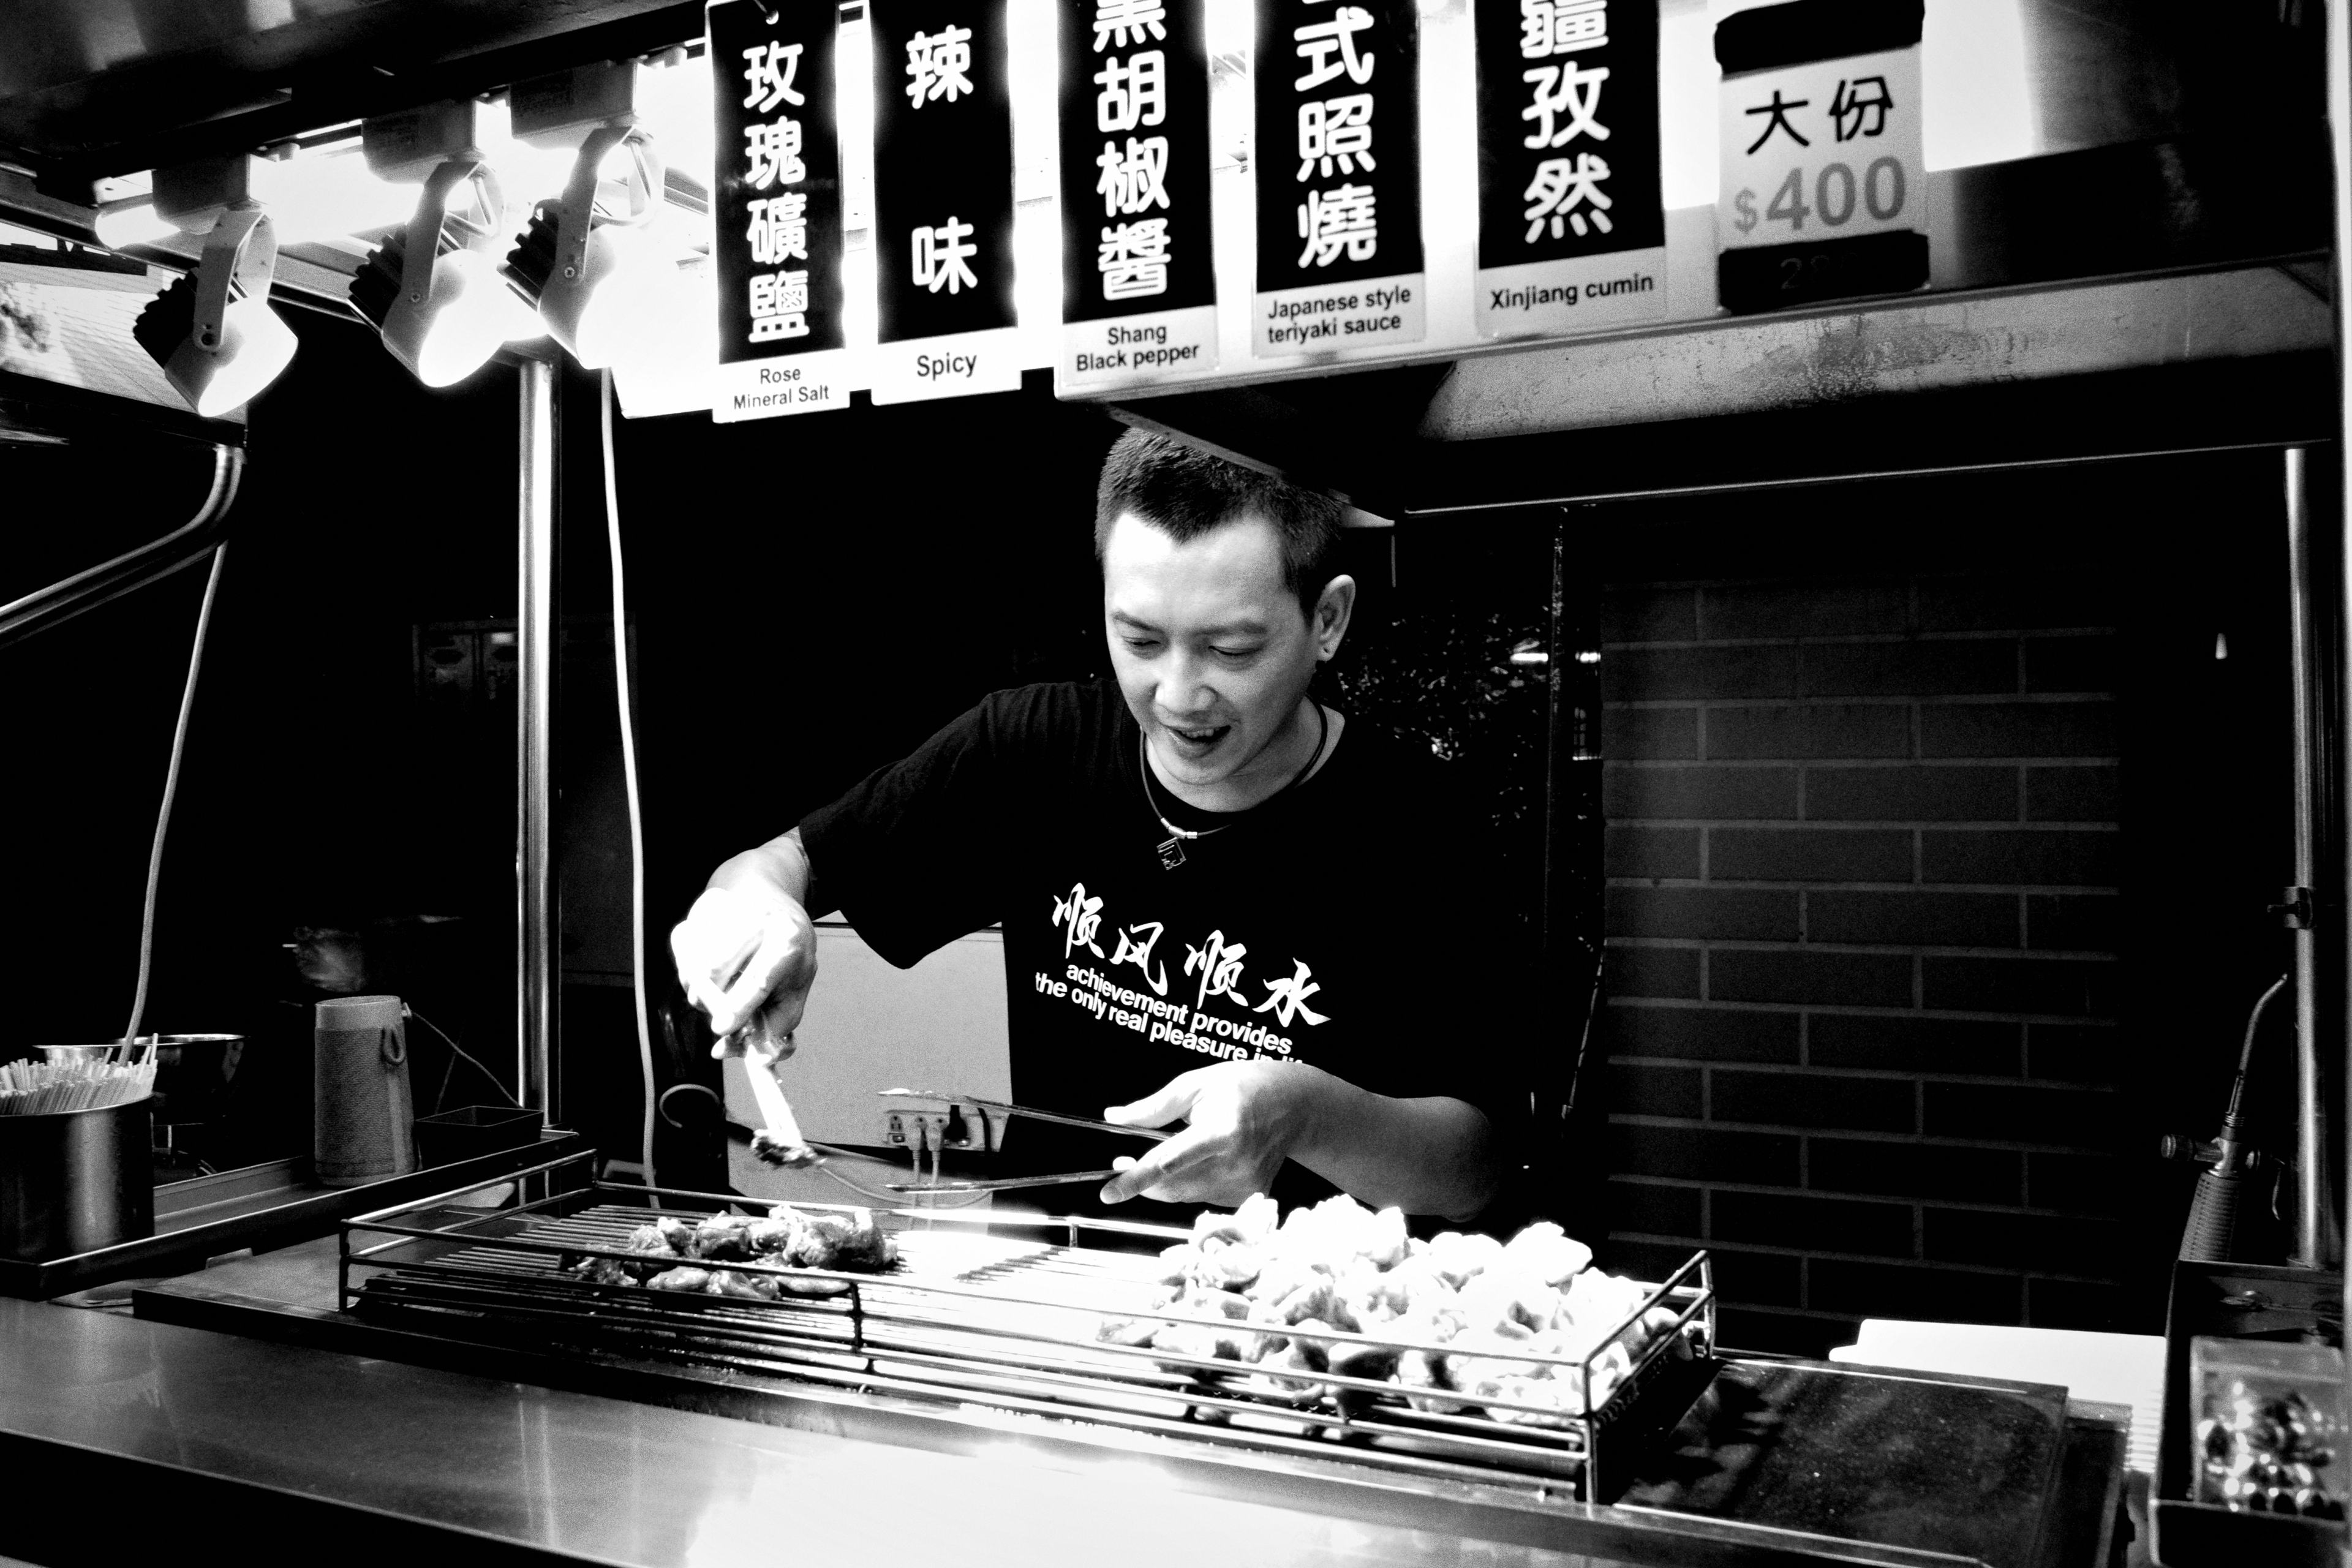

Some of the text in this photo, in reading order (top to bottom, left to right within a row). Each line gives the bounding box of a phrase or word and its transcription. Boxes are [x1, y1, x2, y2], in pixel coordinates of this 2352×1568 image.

[1294, 0, 1377, 268] 式照燒
[1744, 76, 1894, 156] 大份
[905, 24, 979, 295] 辣味
[742, 40, 810, 344] 玫瑰礦鹽
[1733, 156, 1906, 234] $400
[1268, 284, 1411, 320] Japanese style
[1491, 273, 1654, 311] Xinjiang cumin
[1108, 326, 1167, 345] Shang
[1268, 315, 1401, 344] teriyaki sauce
[760, 368, 801, 384] Rose
[917, 353, 977, 380] Spicy
[1076, 344, 1199, 371] Black pepper
[734, 385, 829, 409] Mineral Salt
[1035, 971, 1068, 998] the
[1071, 988, 1107, 1020] only
[1108, 1006, 1149, 1033] real
[1149, 1020, 1248, 1061] pleasure
[1066, 964, 1293, 1055] achievement provides
